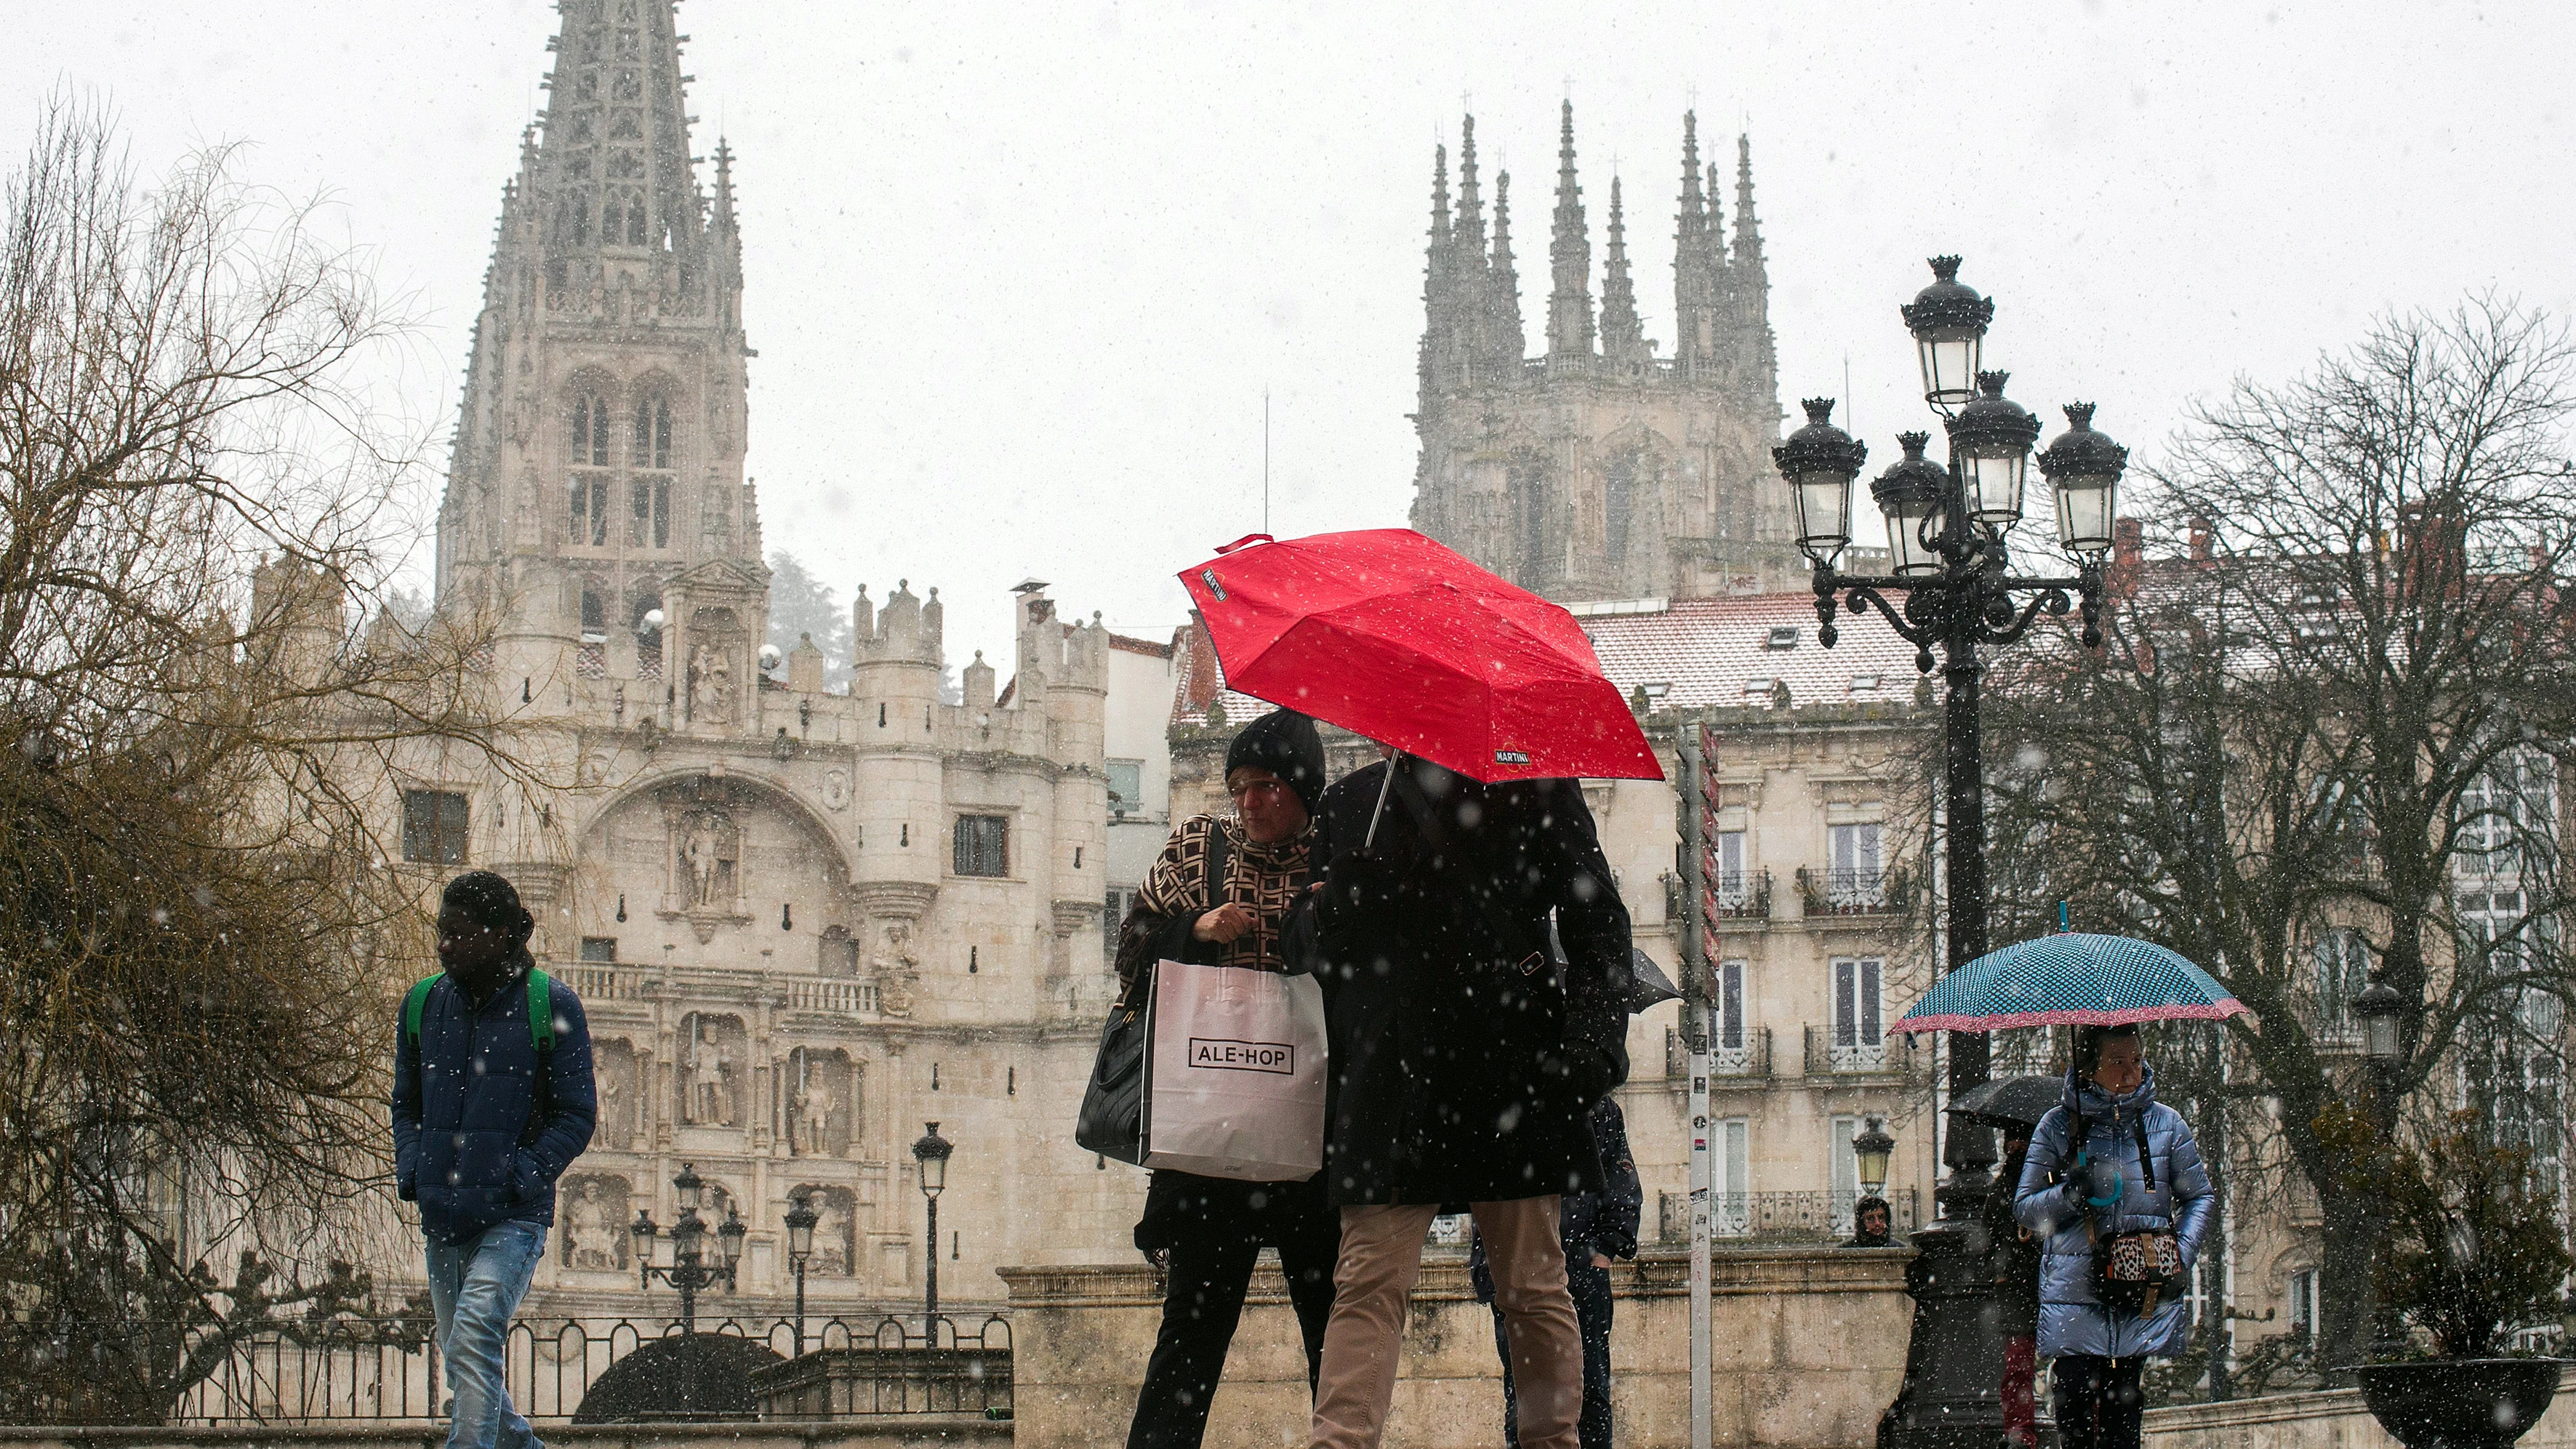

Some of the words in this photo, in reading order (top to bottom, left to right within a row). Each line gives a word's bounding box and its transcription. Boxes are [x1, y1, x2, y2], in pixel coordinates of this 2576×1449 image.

[1203, 569, 1227, 601] MARTINI
[1496, 752, 1528, 763] MARTINI
[1198, 1046, 1285, 1066] ALE-HOP
